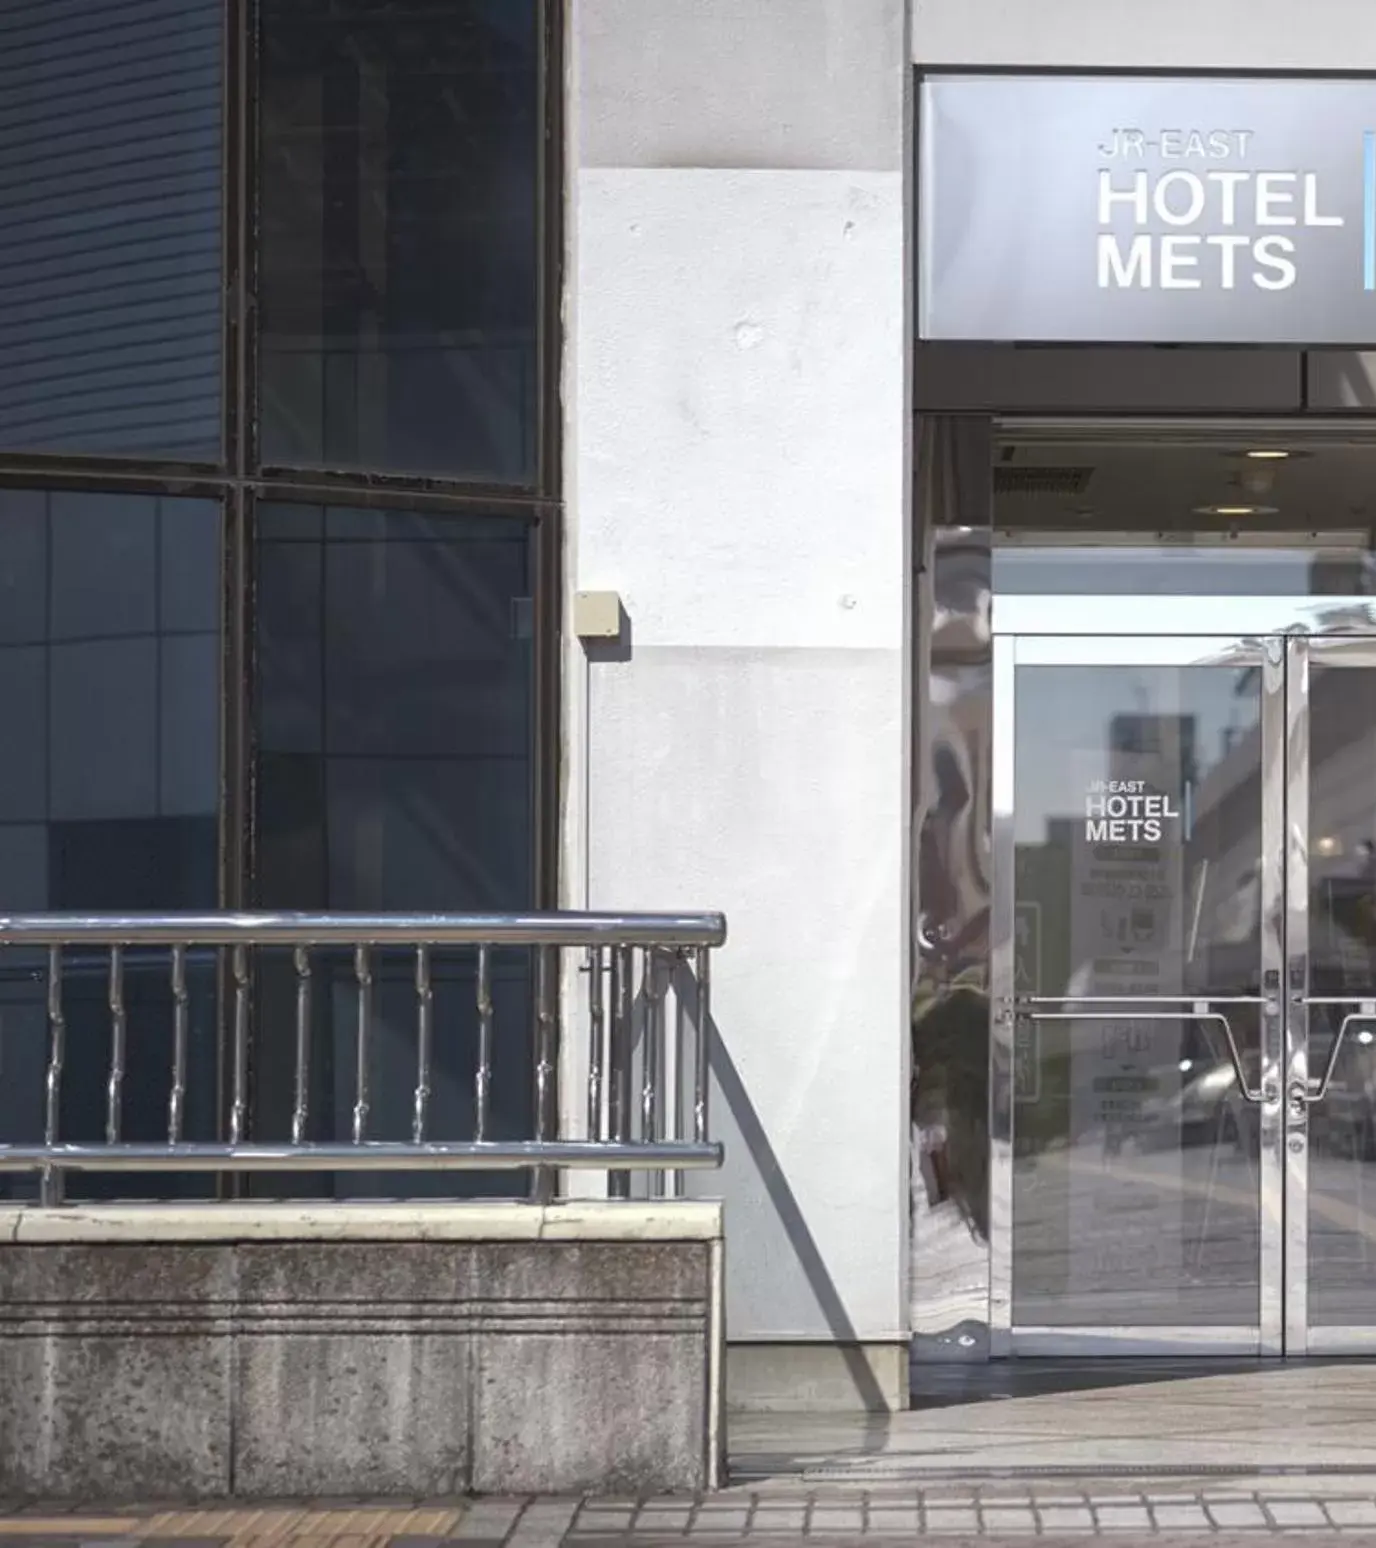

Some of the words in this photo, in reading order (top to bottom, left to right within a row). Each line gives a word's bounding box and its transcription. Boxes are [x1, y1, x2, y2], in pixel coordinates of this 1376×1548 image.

[1097, 127, 1254, 159] JR-EAST
[1097, 168, 1344, 227] HOTEL
[1097, 232, 1297, 291] METS
[1085, 795, 1180, 818] HOTEL
[1085, 819, 1162, 842] METS
